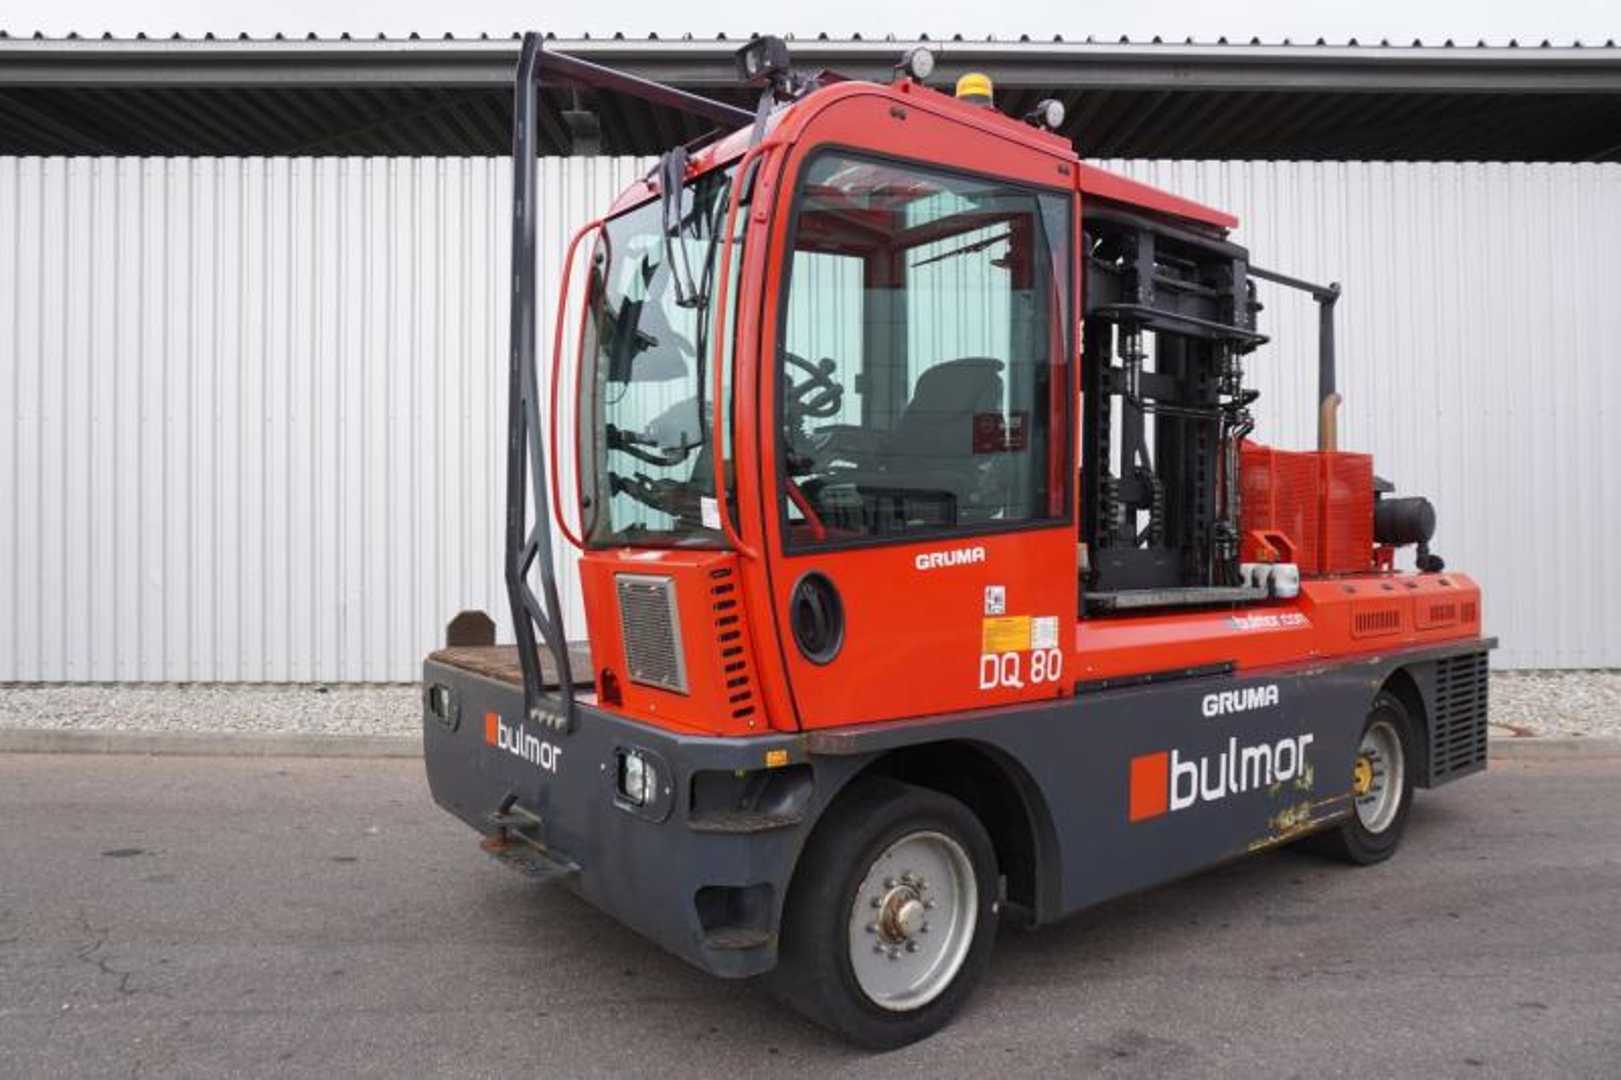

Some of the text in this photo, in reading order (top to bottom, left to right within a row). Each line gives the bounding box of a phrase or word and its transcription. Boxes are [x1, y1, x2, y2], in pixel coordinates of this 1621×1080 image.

[915, 547, 986, 570] GRUMA
[980, 648, 1062, 690] DQ 80
[1202, 684, 1279, 717] GRUMA
[497, 714, 562, 773] bulmor
[1169, 733, 1314, 811] bulmor
